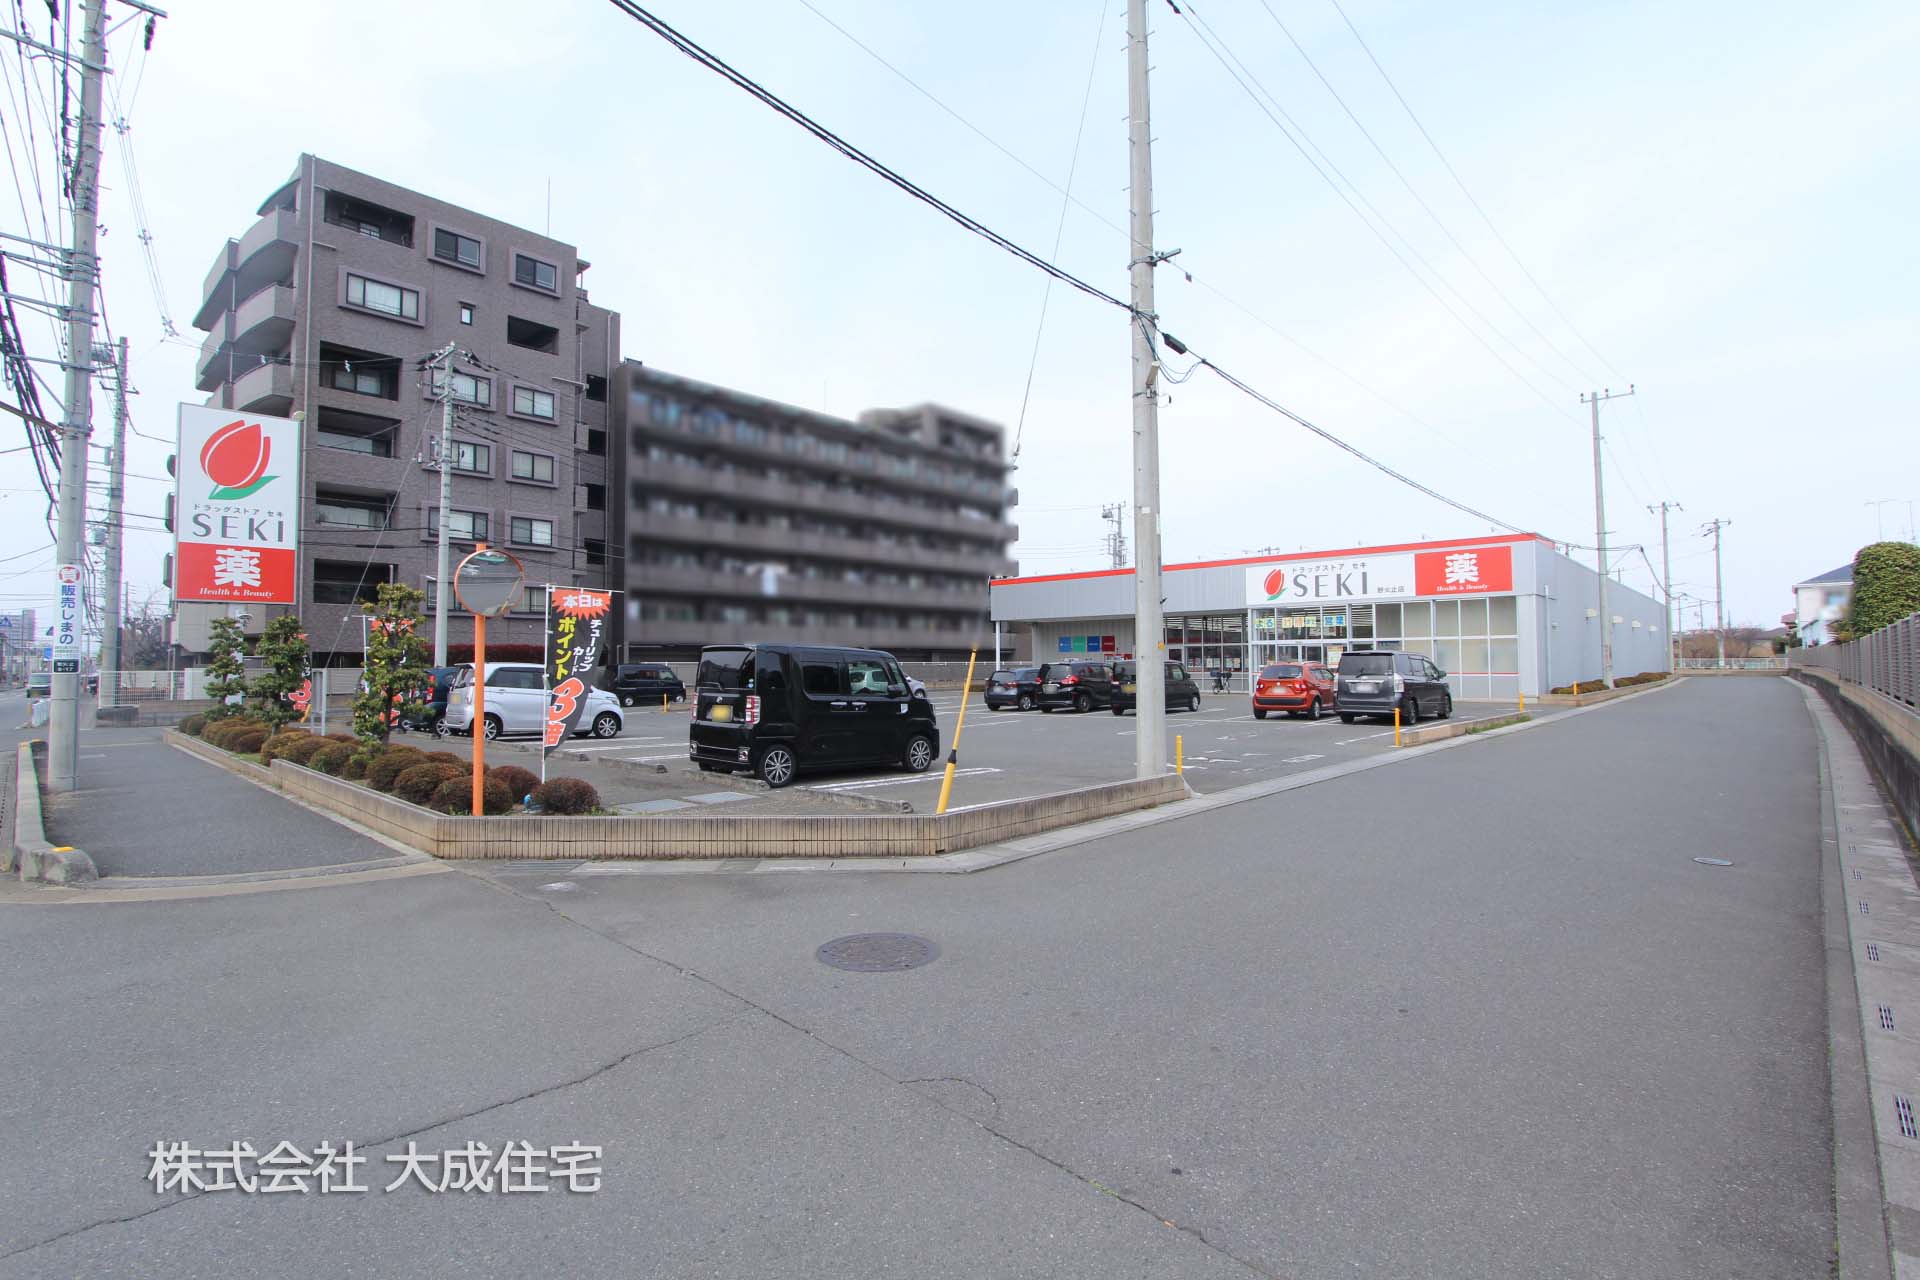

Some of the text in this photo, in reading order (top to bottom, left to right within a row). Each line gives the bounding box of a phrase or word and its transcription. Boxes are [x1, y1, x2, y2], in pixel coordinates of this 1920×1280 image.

[194, 503, 284, 519] ドラッグストア セキ
[192, 513, 284, 542] SEKI
[214, 548, 262, 588] 薬
[1292, 561, 1367, 574] ドラッグストア セキ
[1445, 552, 1480, 585] 薬
[199, 587, 274, 599] Health & Beauty
[1292, 571, 1368, 597] SEKI
[1466, 583, 1489, 591] Beauty
[563, 594, 603, 608] 本日は
[555, 616, 577, 681] ポイント
[579, 619, 603, 672] チューリップ
[572, 646, 584, 676] カード
